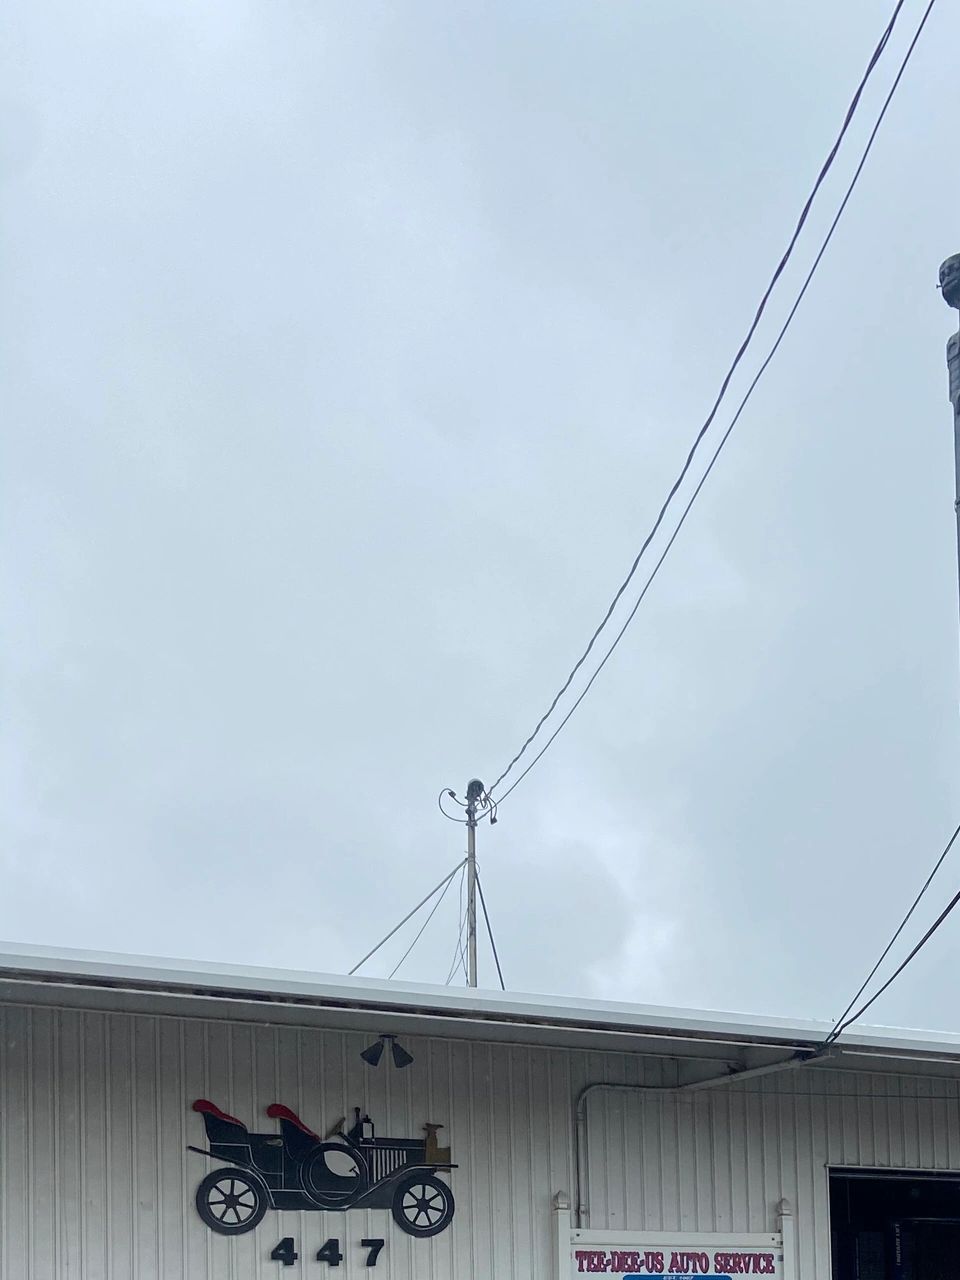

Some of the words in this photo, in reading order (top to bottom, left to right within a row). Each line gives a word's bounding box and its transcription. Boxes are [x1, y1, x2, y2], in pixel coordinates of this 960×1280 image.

[575, 1250, 664, 1274] TEE-DEE-US
[668, 1252, 710, 1274] AUTO
[714, 1252, 776, 1274] SERVICE
